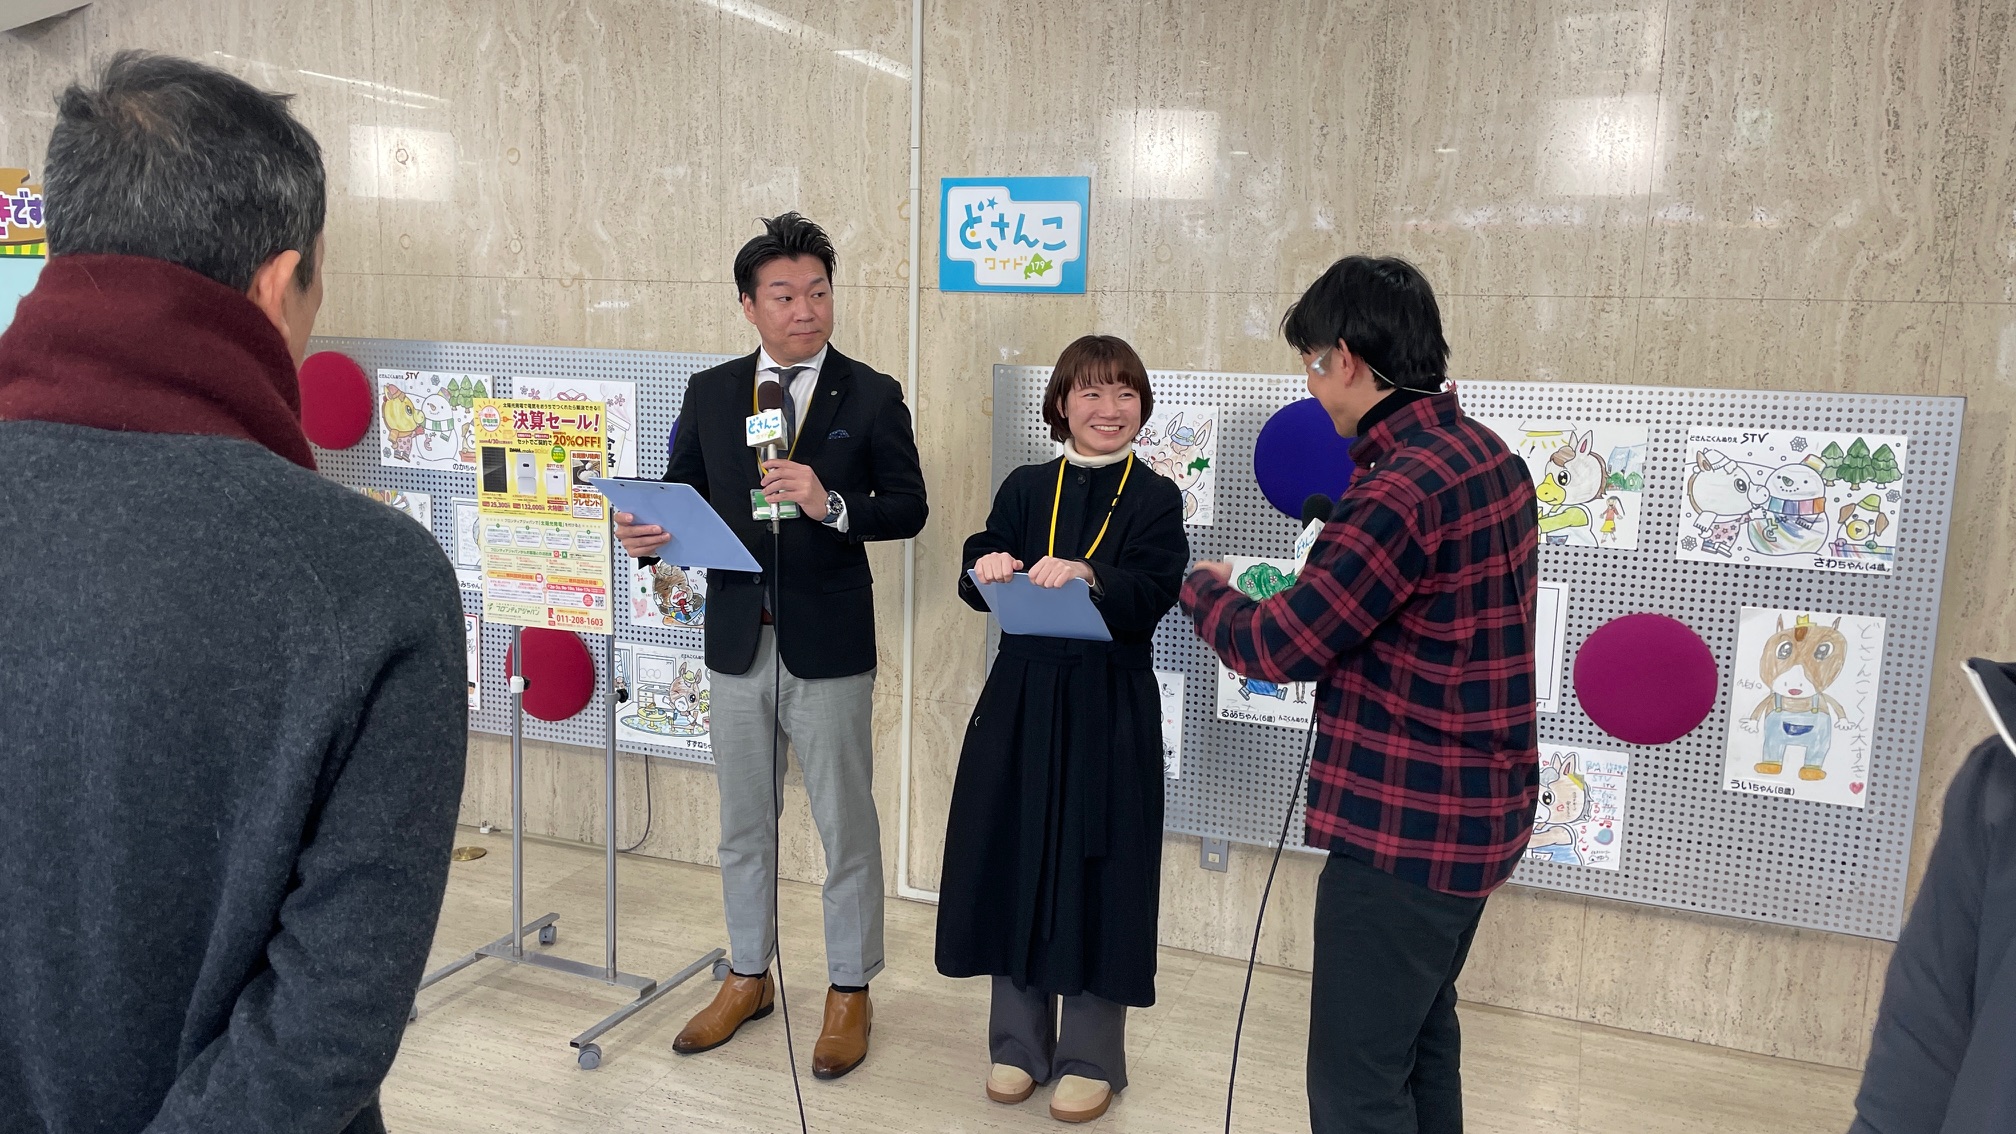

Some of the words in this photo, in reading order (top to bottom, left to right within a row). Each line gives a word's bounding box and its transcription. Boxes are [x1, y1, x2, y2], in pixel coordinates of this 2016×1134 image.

[959, 199, 1067, 252] どさんこ
[984, 256, 1028, 270] ワイド
[1031, 261, 1045, 271] 179
[405, 371, 420, 381] STV
[513, 409, 600, 432] 決算セール!
[748, 416, 780, 434] どさんこ
[553, 434, 601, 449] 20%OFF!
[1689, 434, 1738, 444] どさんこくんぬりえ
[1740, 431, 1770, 444] STV
[556, 614, 604, 627] 011-208-1603
[1850, 622, 1881, 779] どさんこくん大すき
[1730, 779, 1795, 796] ういちゃん(8歳)
